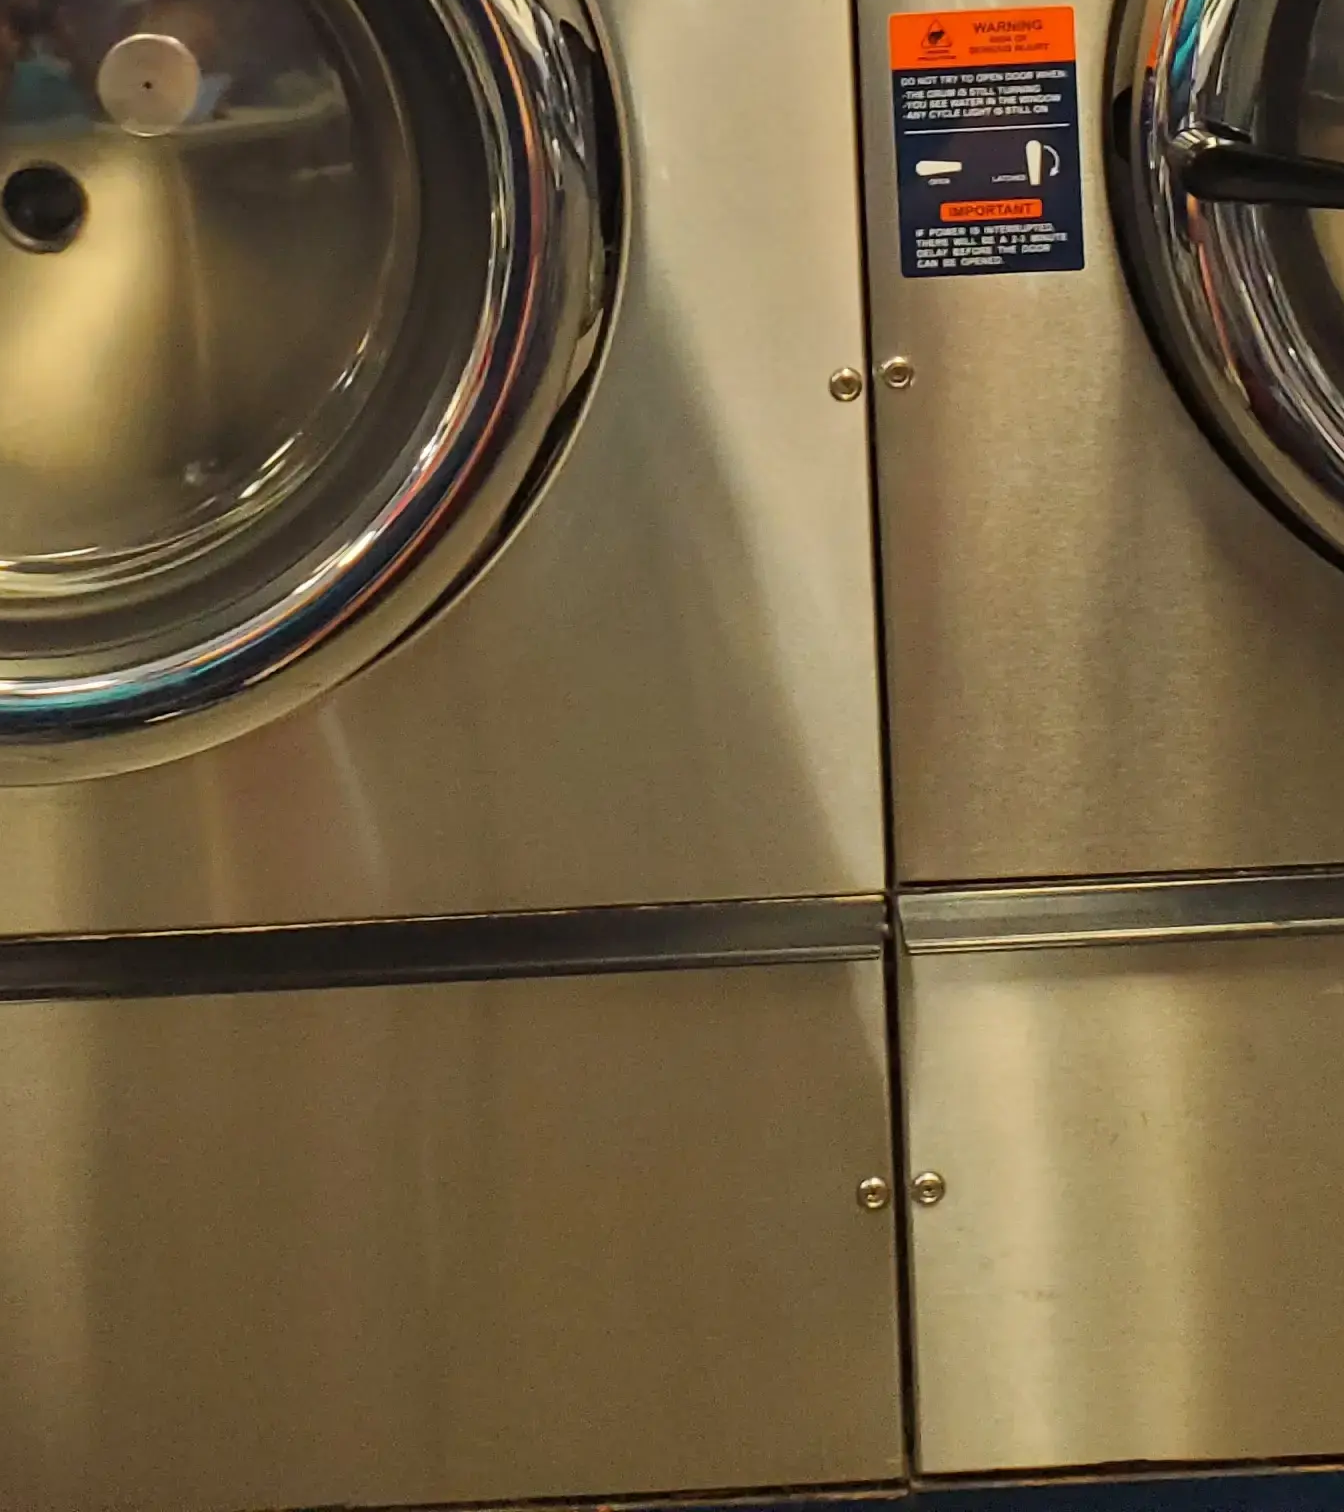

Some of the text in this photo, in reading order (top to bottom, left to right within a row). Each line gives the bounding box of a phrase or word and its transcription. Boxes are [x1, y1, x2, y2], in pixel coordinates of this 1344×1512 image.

[974, 20, 1043, 33] WARNING
[901, 77, 915, 86] DO
[917, 76, 937, 85] NOT
[940, 75, 958, 84] TRY
[962, 74, 974, 83] TO
[976, 73, 1003, 82] OPEN
[969, 87, 996, 96] STILL
[951, 98, 983, 107] WATER
[929, 110, 960, 119] CYCLE
[963, 108, 991, 116] LIGHT
[1005, 106, 1031, 115] STILL
[949, 203, 1033, 216] IMPORTANT
[916, 238, 948, 247] THERE
[916, 249, 948, 257] DELAY
[917, 259, 938, 268] CAN
